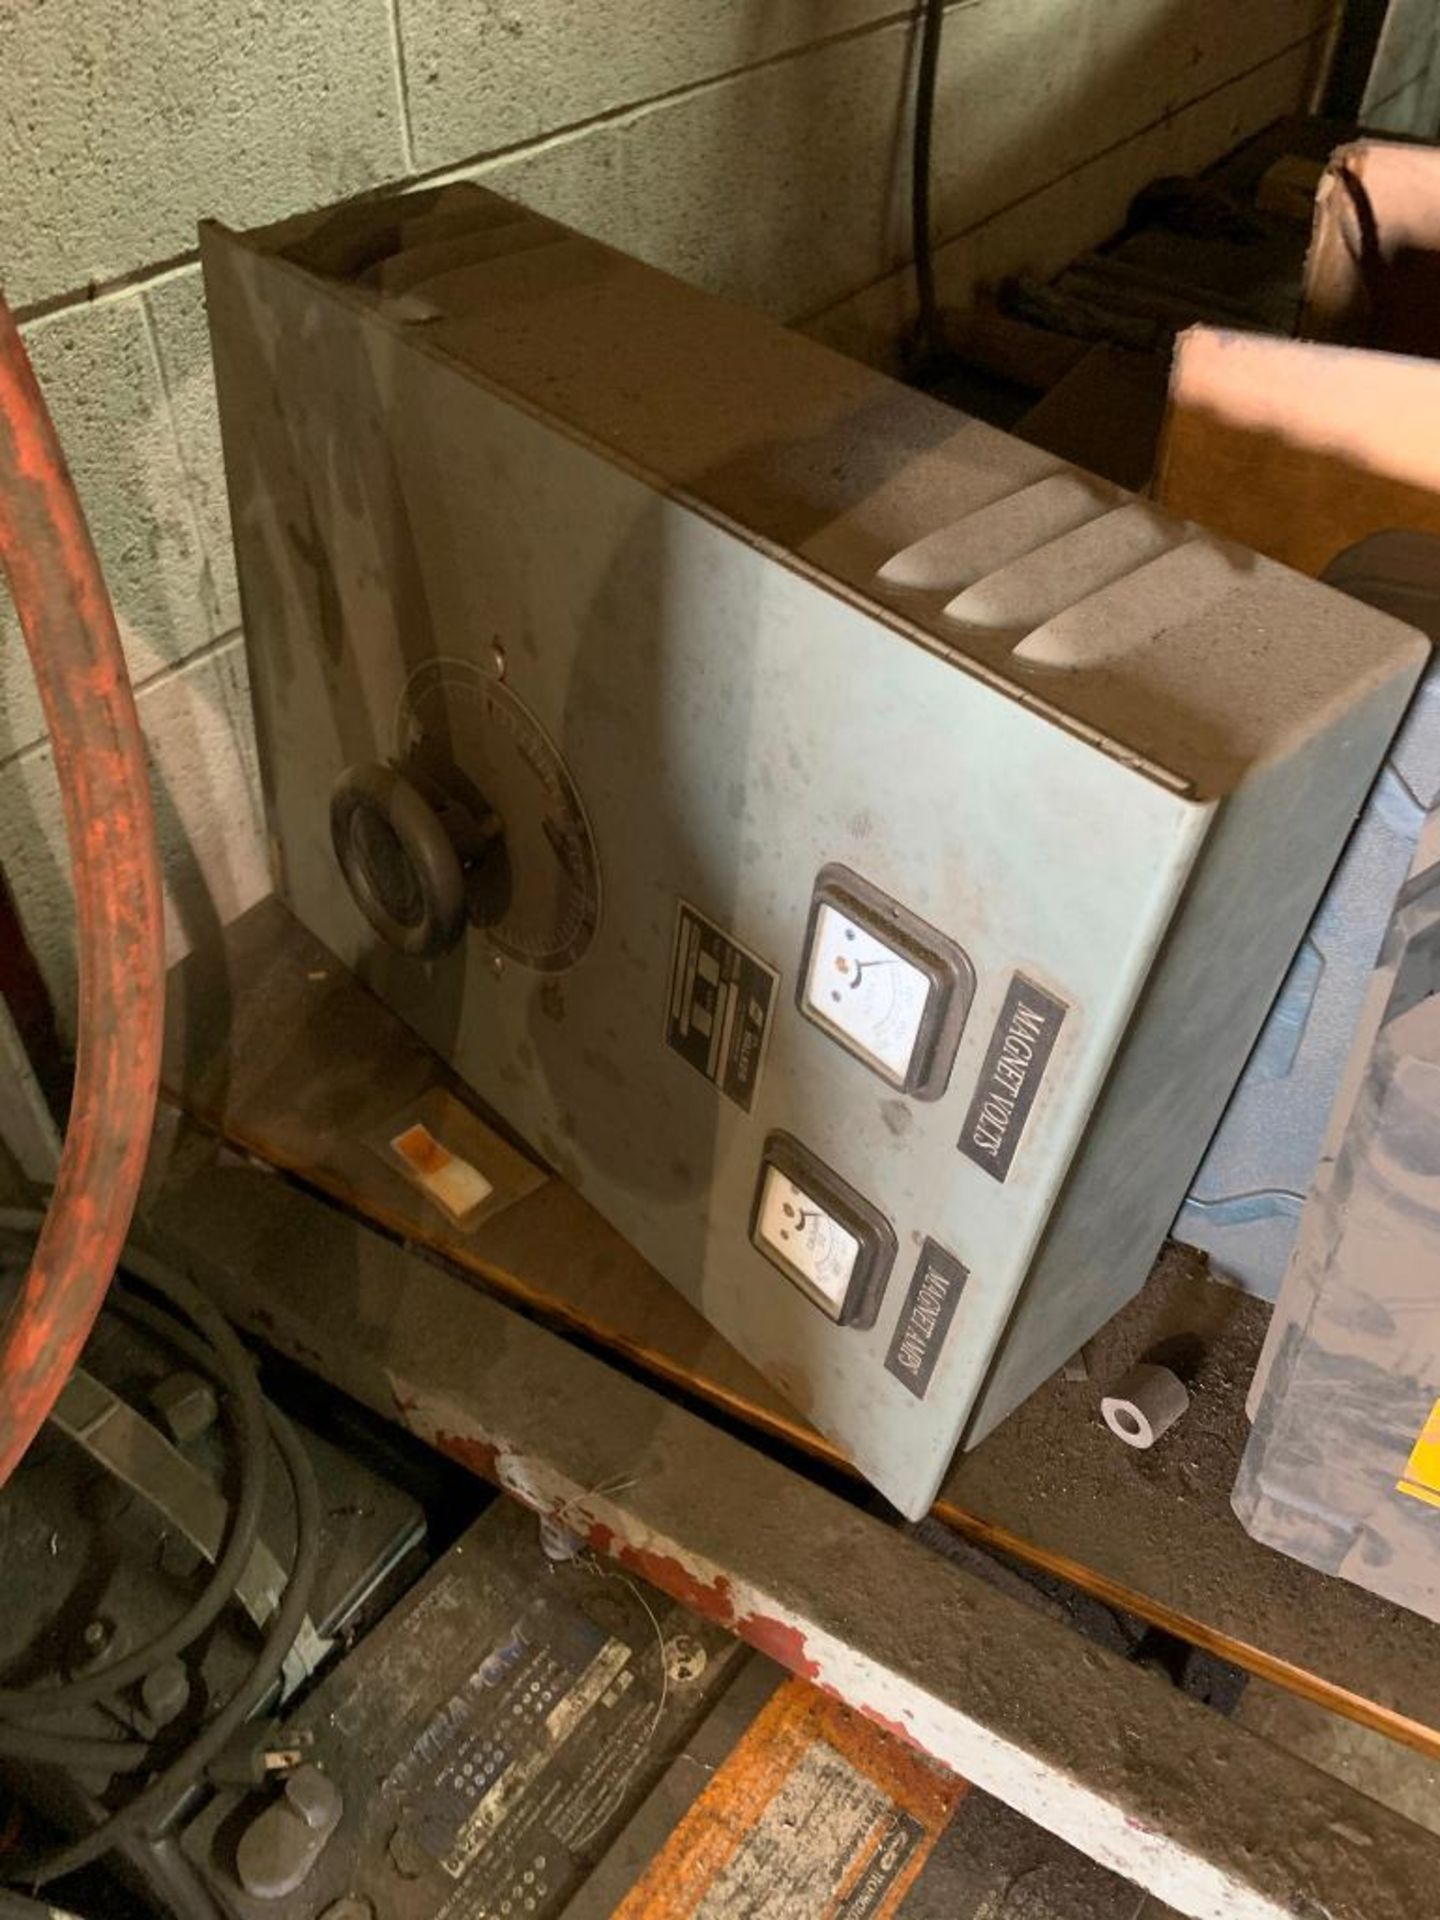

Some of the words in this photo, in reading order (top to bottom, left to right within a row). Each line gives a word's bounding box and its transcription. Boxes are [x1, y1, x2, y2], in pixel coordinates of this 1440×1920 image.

[992, 1001, 1046, 1099] MAGNET
[973, 1091, 1015, 1157] VOLTS
[910, 1264, 951, 1339] MAGNET
[897, 1325, 927, 1376] AMPS
